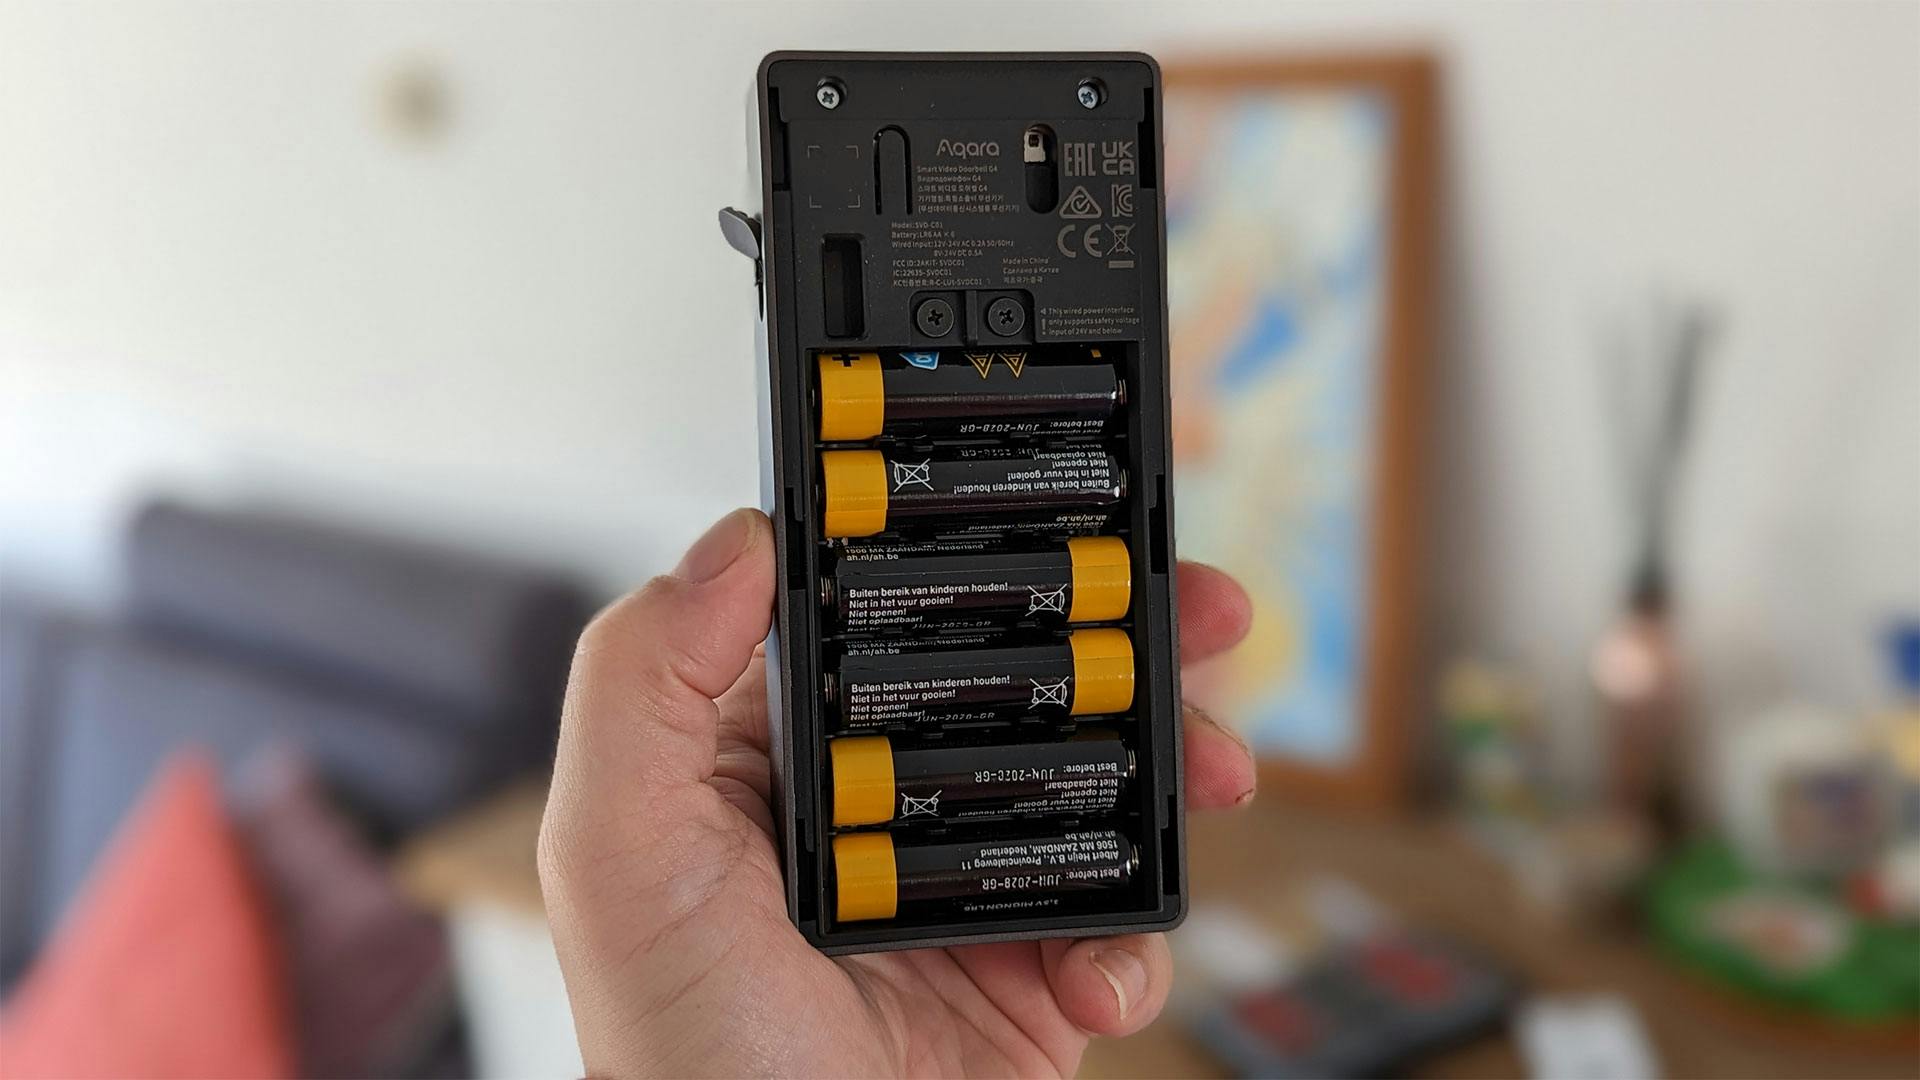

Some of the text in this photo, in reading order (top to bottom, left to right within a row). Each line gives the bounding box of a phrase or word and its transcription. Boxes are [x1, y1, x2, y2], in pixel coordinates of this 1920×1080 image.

[936, 139, 1000, 159] Aqara
[1102, 142, 1134, 158] UK
[1102, 159, 1135, 176] CA
[1049, 420, 1082, 428] before:
[1051, 459, 1108, 469] Niet openen!
[1007, 468, 1110, 481] Niet in het vuur gooien!
[953, 479, 1110, 495] Buiten bereik van kinderen houden!
[846, 553, 899, 562] ah.nl/ah.be
[849, 582, 1009, 598] Buiten bereik van kinderen houden!
[849, 595, 954, 609] Niet in het vuur gooien!
[849, 608, 907, 618] Niet openen!
[848, 618, 868, 626] Niet
[847, 647, 900, 657] ah.nl/ah.be
[851, 675, 1011, 693] Buiten bereik van kinderen houden!
[851, 689, 956, 704] Niet in het vuur gooien!
[850, 702, 909, 713] Niet openen!
[850, 713, 870, 721] Niet
[1063, 763, 1096, 774] before:
[1096, 762, 1118, 772] Best
[1044, 778, 1118, 791] Niet oplaadbaar!
[1061, 788, 1118, 799] Niet openen!
[1065, 830, 1115, 841] ah.nl/ah.be
[980, 840, 1118, 858] 1506 MA ZAANDAM, Nederland
[1067, 851, 1090, 862] Heijn
[1092, 850, 1119, 860] Albert
[961, 861, 971, 870] 11
[974, 855, 1042, 869] Provincialeweg
[1066, 869, 1098, 880] before:
[1099, 868, 1120, 878] Best
